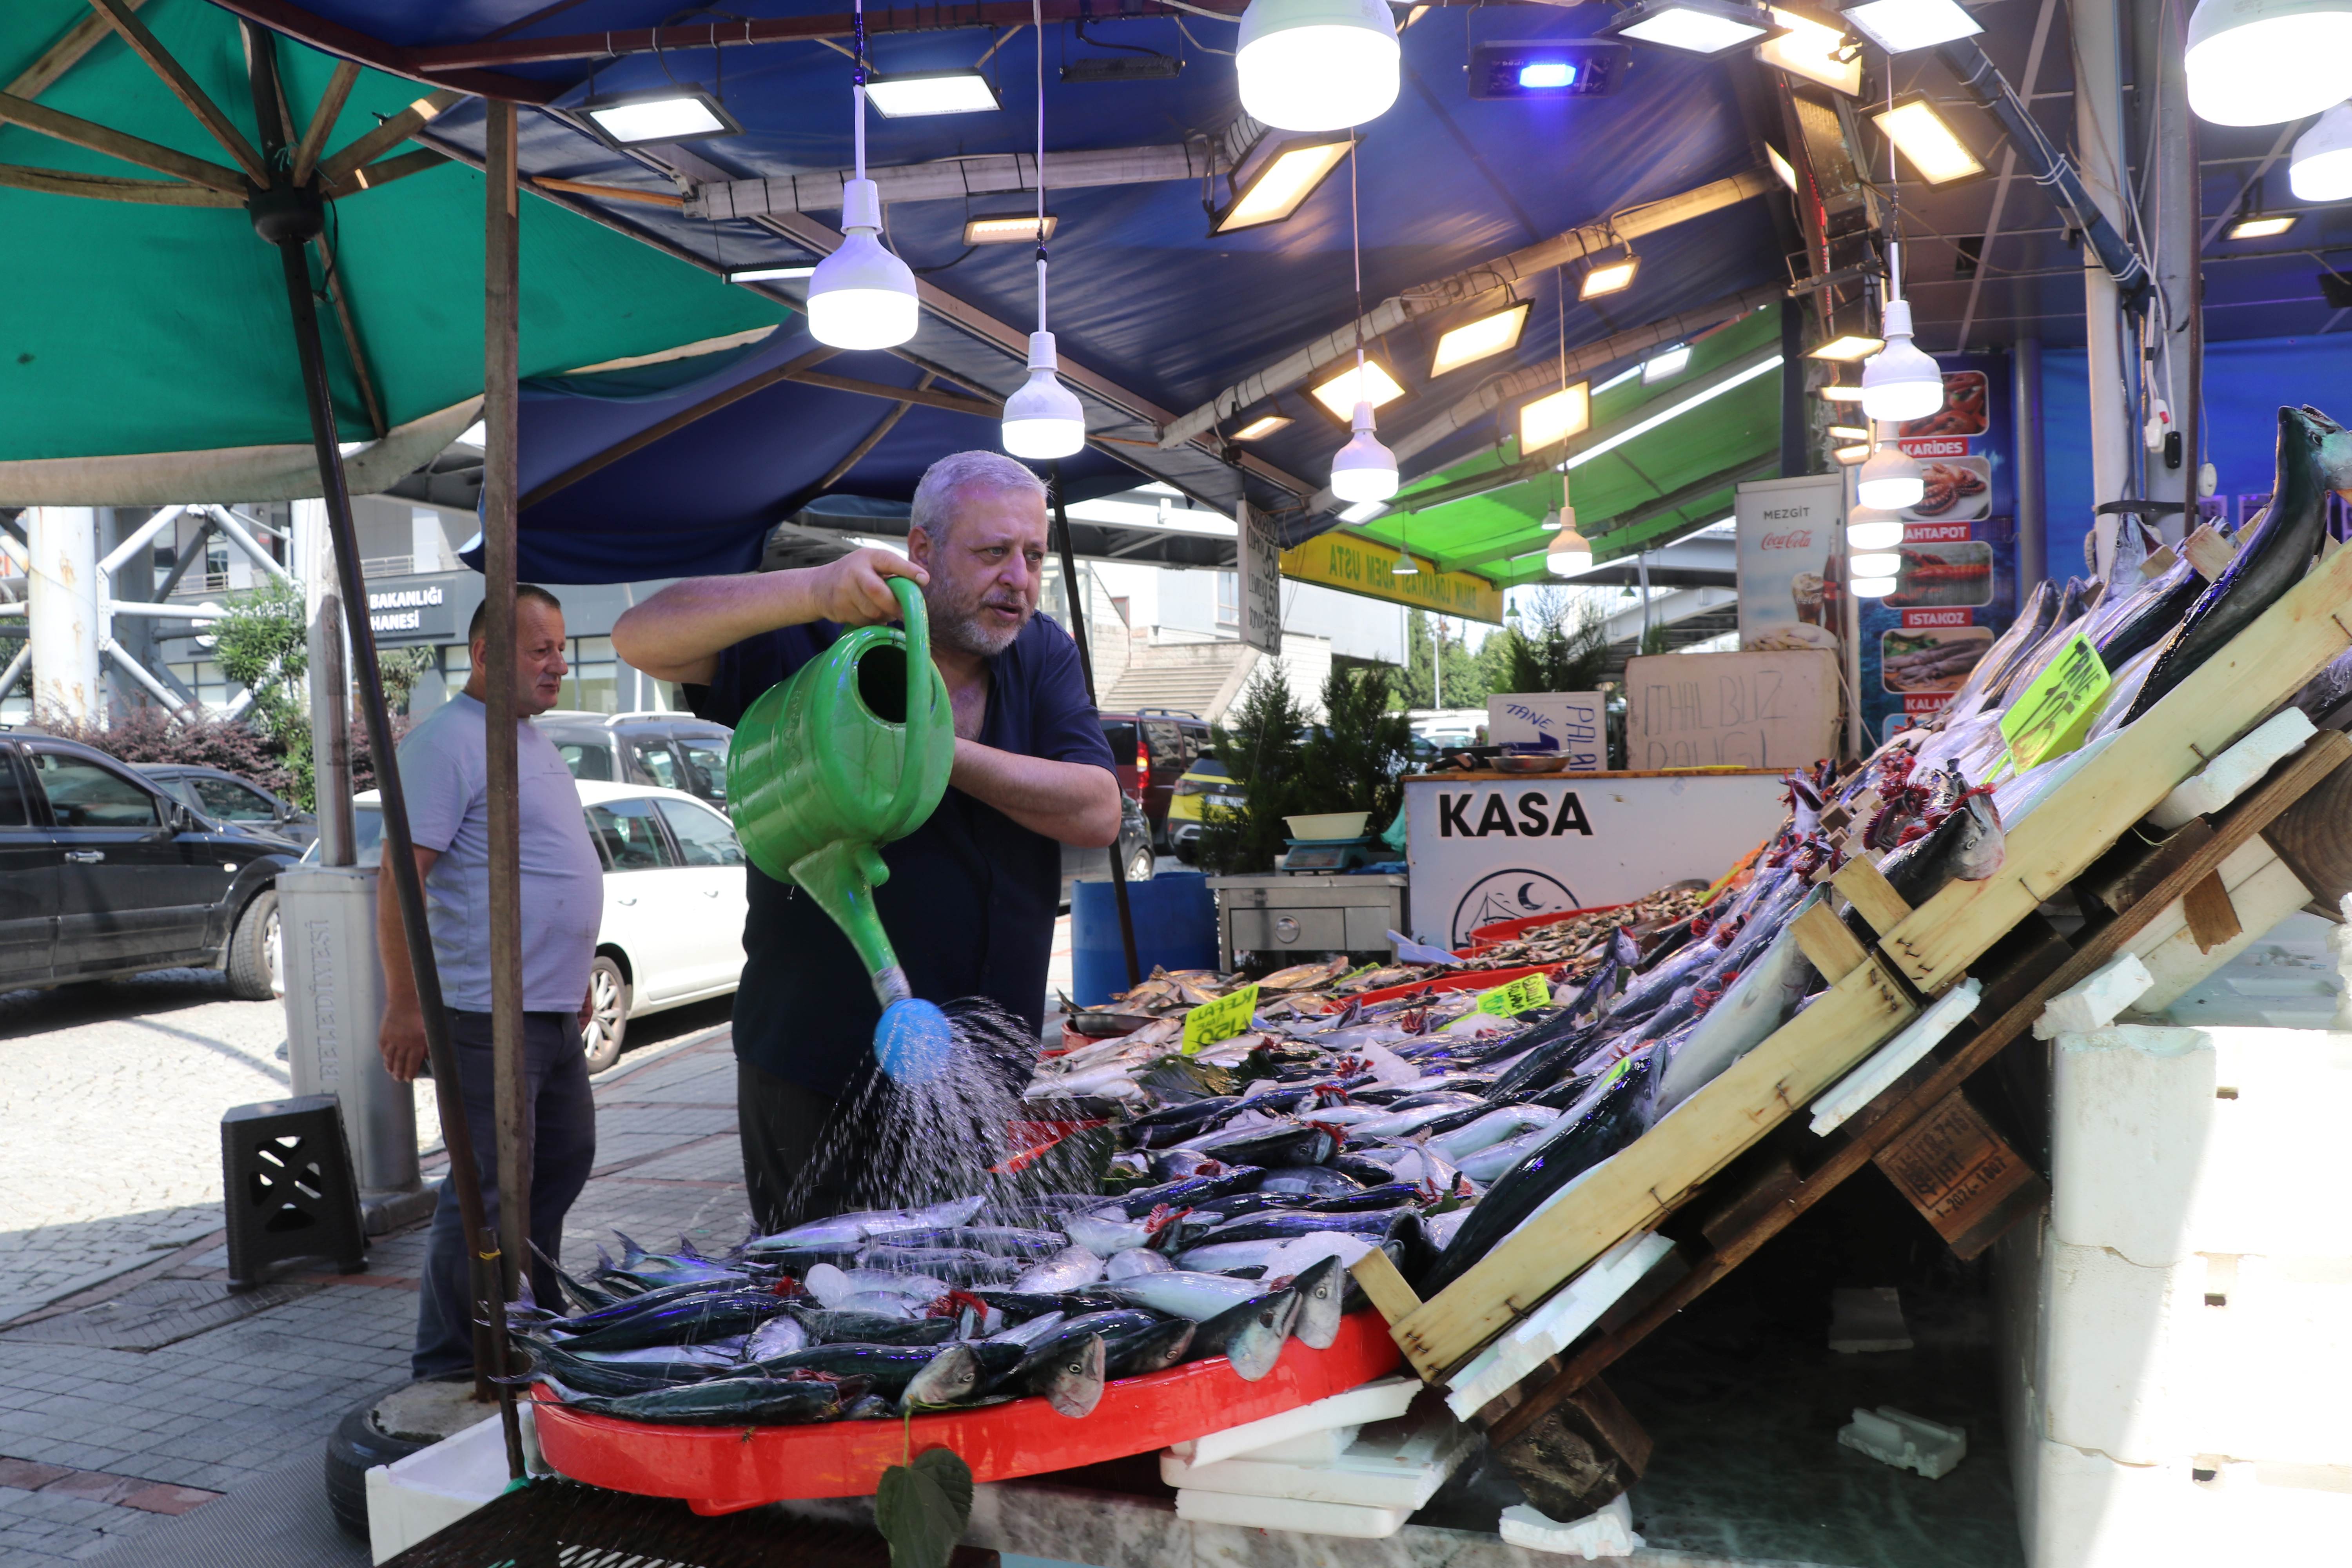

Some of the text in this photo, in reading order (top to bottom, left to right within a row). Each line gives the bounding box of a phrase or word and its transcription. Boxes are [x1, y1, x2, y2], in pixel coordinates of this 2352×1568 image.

[1902, 440, 1964, 455] KARİDES
[1764, 506, 1810, 520] MEZGİT
[1761, 530, 1814, 550] Coca-Cola
[1905, 526, 1967, 539] AHTAPOT
[370, 586, 442, 610] BAKANLIĞI
[370, 610, 419, 631] HANESİ
[1908, 612, 1965, 625] ISTAKOZ
[1720, 670, 1788, 727] BUZ
[1506, 704, 1556, 729] TANE
[1439, 792, 1593, 837] KASA
[305, 920, 340, 1082] BELEDİYESİ
